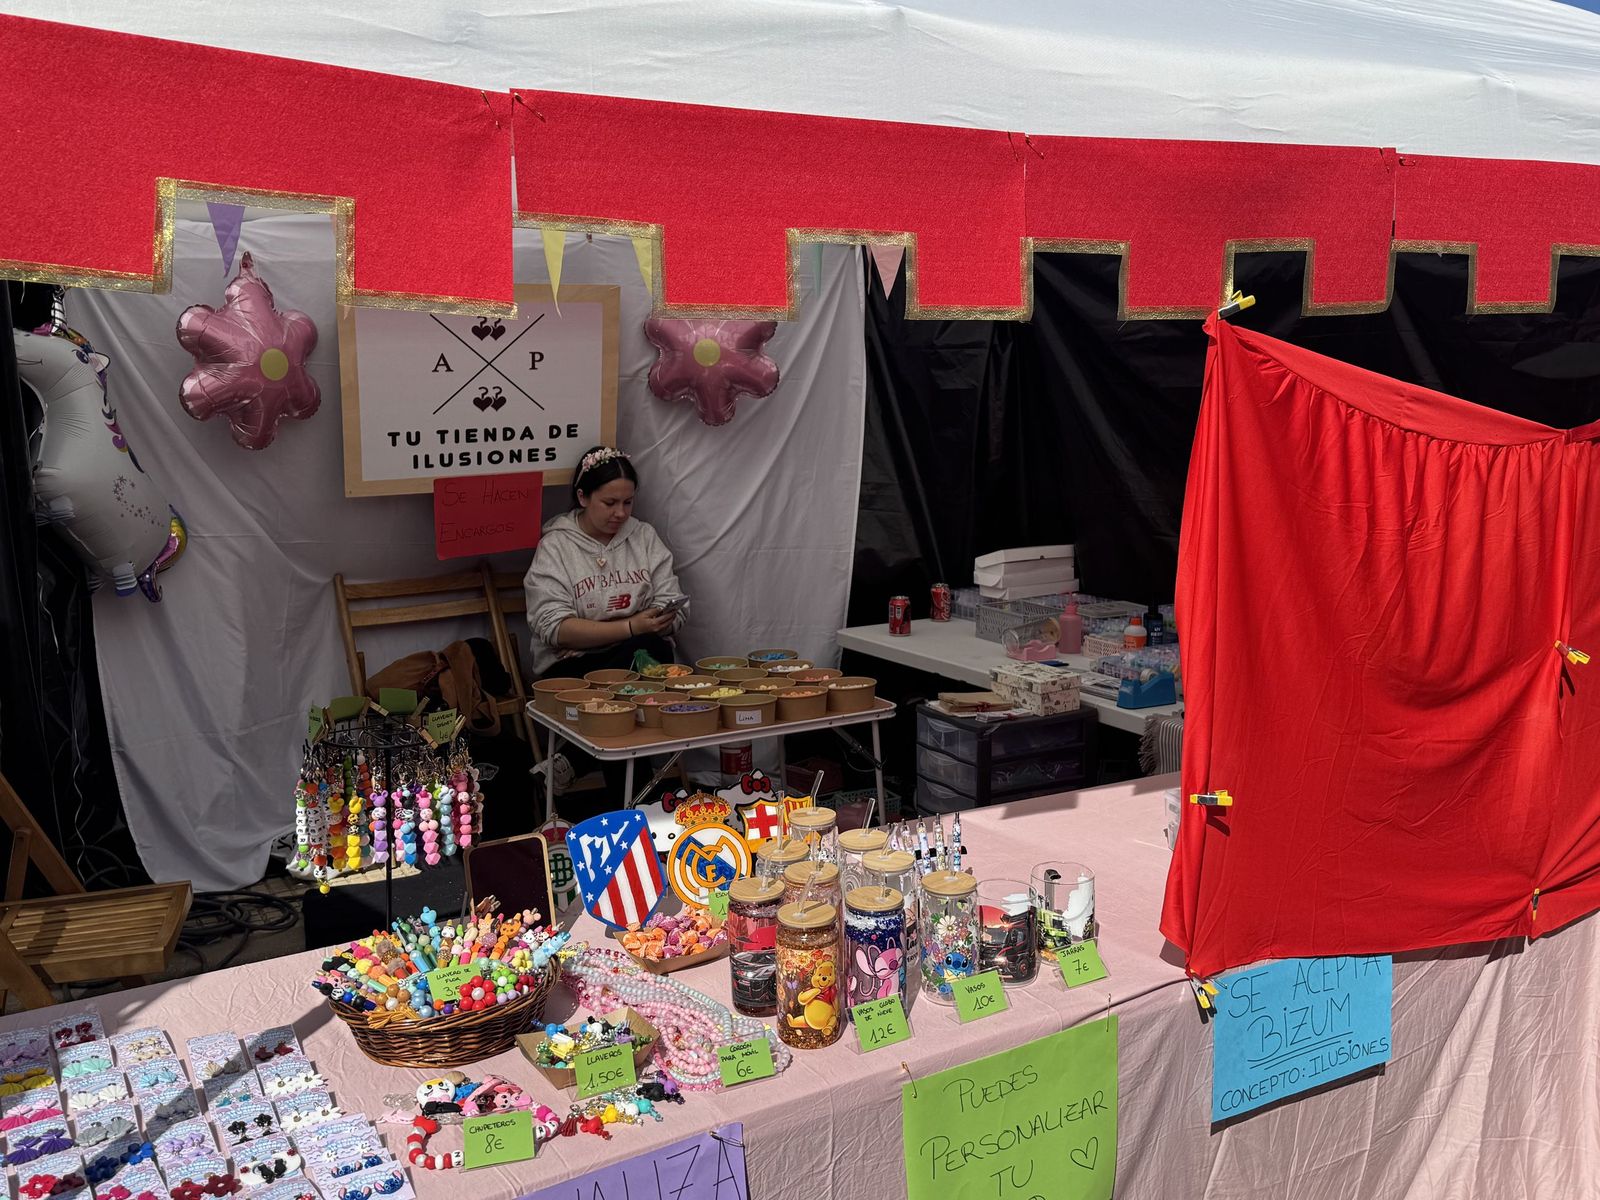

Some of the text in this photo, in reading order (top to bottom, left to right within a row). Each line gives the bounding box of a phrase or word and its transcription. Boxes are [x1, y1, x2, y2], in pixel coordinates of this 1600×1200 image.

[432, 353, 454, 372] A
[529, 352, 545, 370] P
[387, 423, 579, 447] TU TIENDA DE
[412, 447, 557, 469] ILUSIONES
[440, 522, 514, 544] ENCARGOS
[1060, 945, 1085, 958] JARRAS
[1072, 959, 1089, 974] 7€
[965, 982, 986, 994] VASOS
[1228, 971, 1269, 1018] SE
[857, 1006, 874, 1016] VASOS
[973, 994, 995, 1012] 10€
[870, 1023, 896, 1044] 12€
[586, 1048, 623, 1066] LLAVEROS
[720, 1054, 737, 1062] PARA
[736, 1060, 754, 1078] 6€
[584, 1067, 624, 1091] 1,50€
[942, 1064, 1039, 1113] PUEDES
[469, 1118, 516, 1134] CHUPETEROS
[919, 1090, 1108, 1180] PERSONALIZAR
[485, 1133, 505, 1154] 8€
[989, 1159, 1034, 1196] TU
